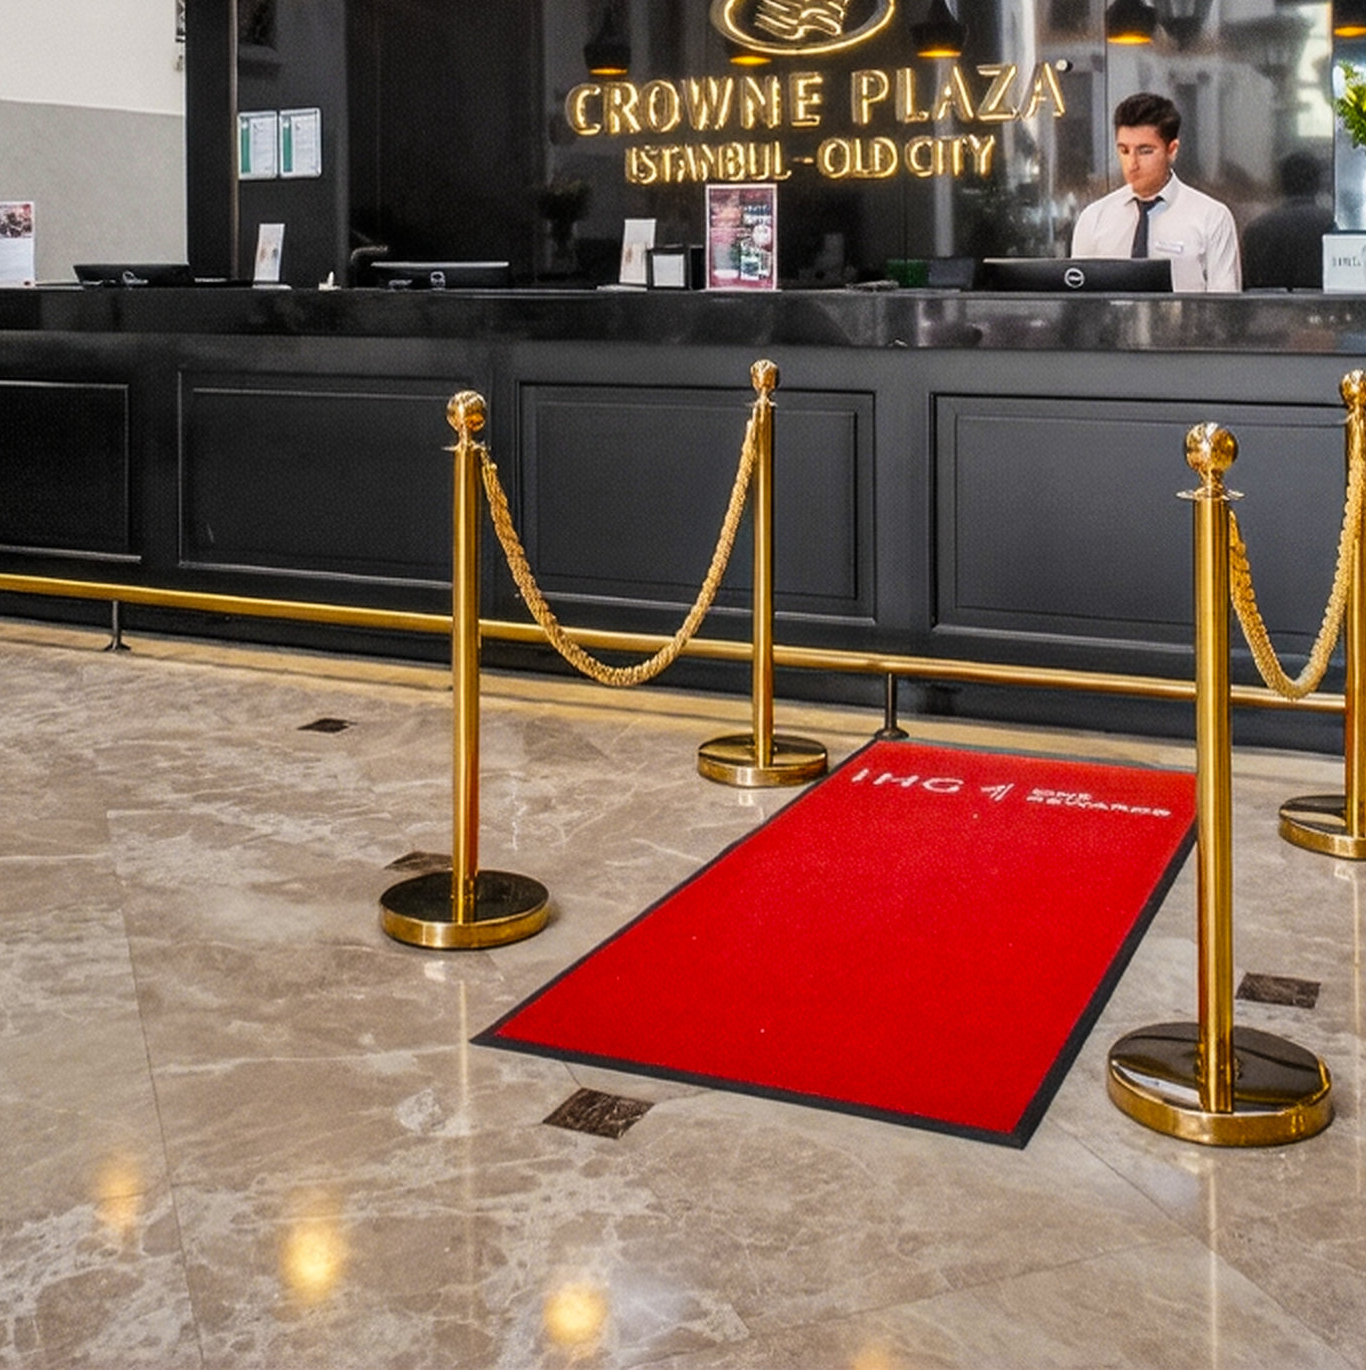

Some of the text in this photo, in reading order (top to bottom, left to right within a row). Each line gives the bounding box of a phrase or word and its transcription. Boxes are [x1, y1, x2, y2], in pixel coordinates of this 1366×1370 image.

[565, 62, 1066, 136] CROWNE PLAZA
[624, 140, 792, 185] ISTANBUL
[816, 138, 899, 180] OLD
[904, 133, 996, 178] CITY
[851, 768, 964, 794] IHG
